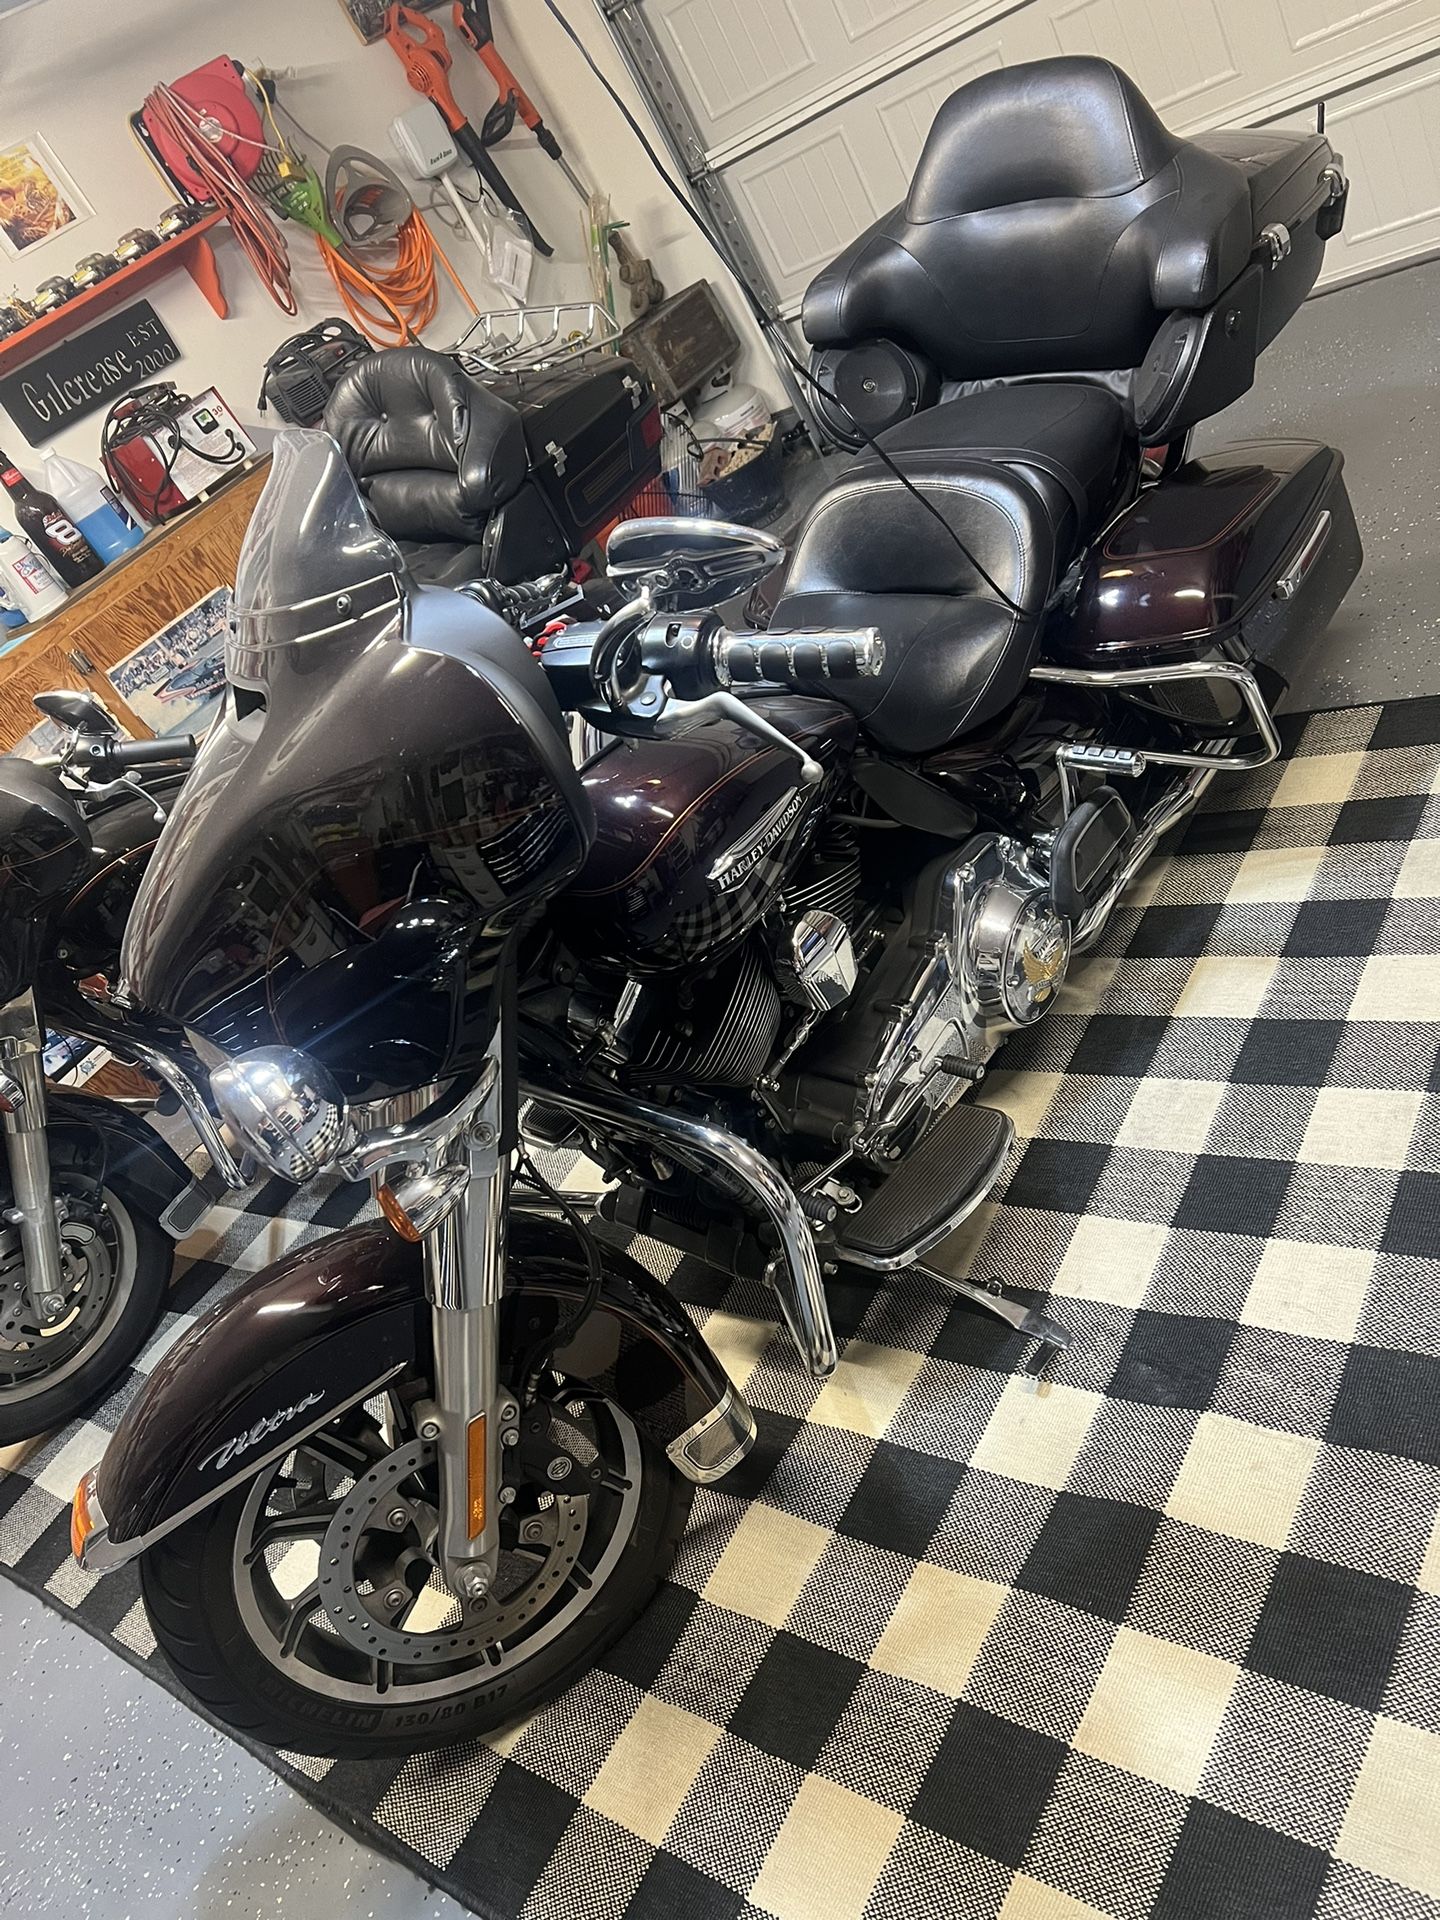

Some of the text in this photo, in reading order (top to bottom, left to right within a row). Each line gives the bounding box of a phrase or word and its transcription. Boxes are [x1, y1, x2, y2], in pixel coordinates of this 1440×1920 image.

[125, 318, 160, 348] EST
[135, 343, 175, 380] 2000
[21, 350, 133, 422] Gilcrease
[211, 404, 223, 416] 30
[45, 518, 83, 546] 8
[717, 793, 803, 890] HARLEY-DAVIDSON
[198, 1389, 326, 1471] Ultra
[395, 1703, 467, 1728] 130/80
[473, 1683, 509, 1709] B17
